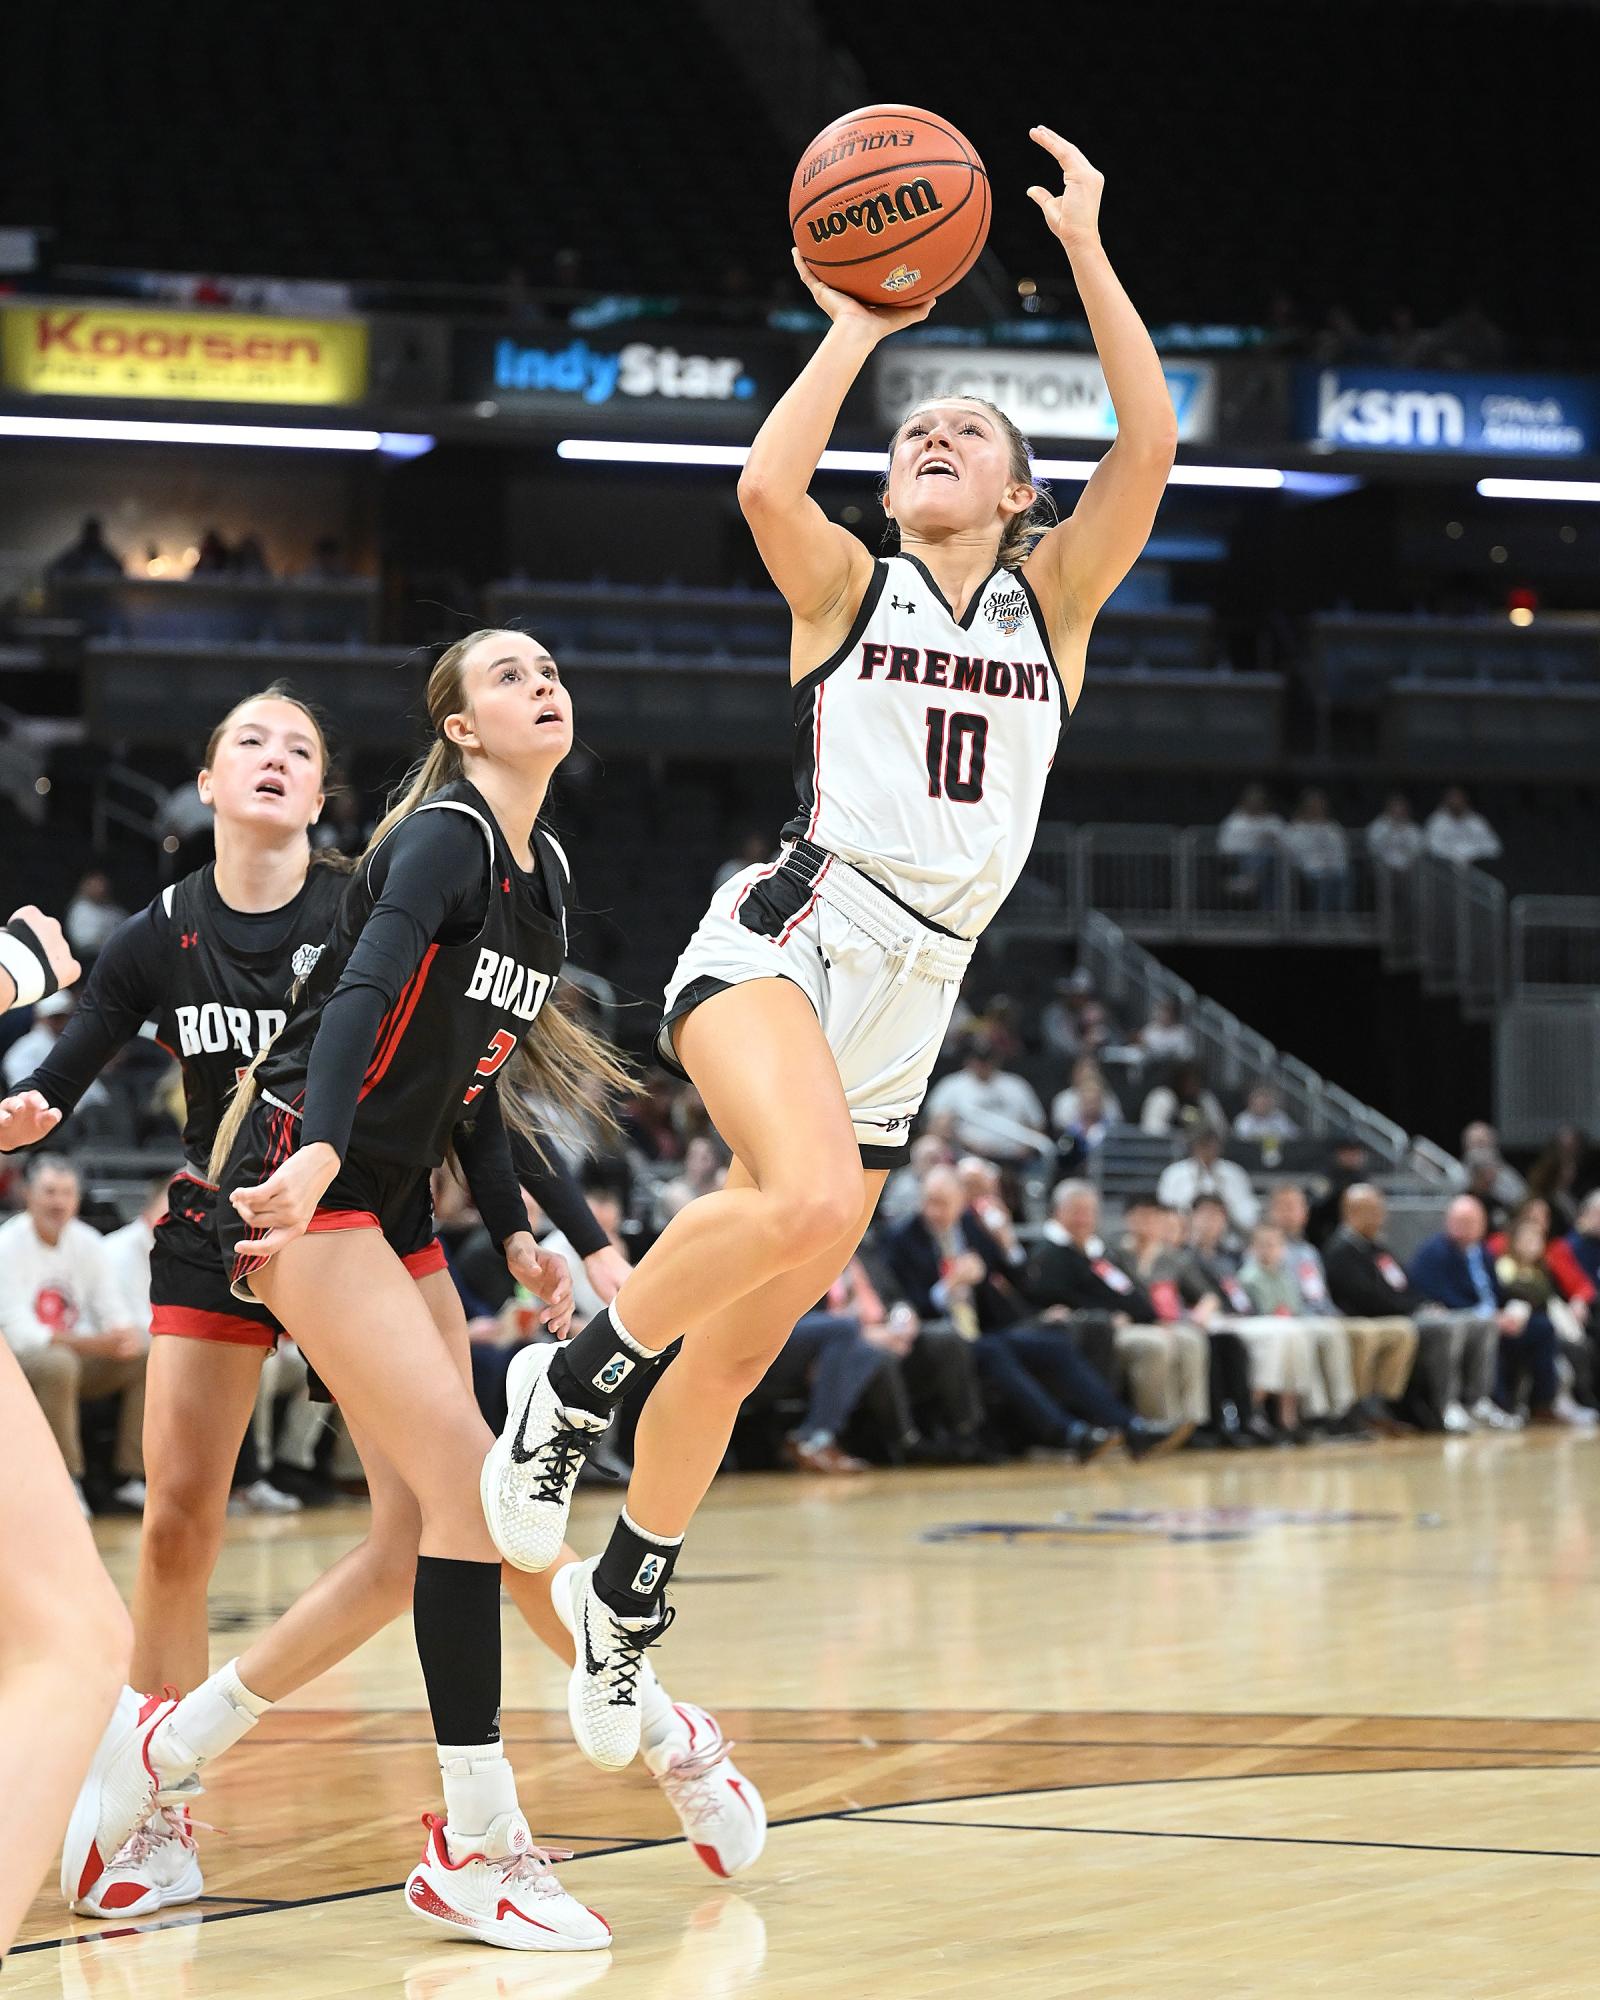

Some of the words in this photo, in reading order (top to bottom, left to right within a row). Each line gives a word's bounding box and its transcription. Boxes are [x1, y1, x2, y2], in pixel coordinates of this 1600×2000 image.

[802, 134, 915, 188] EVOLUTION
[806, 177, 944, 244] Wilson
[36, 310, 322, 366] Koorsen
[1317, 371, 1465, 446] ksm
[984, 589, 1025, 609] State
[984, 600, 1030, 622] Finals
[857, 642, 1050, 702] FREMONT
[925, 706, 989, 805] 10
